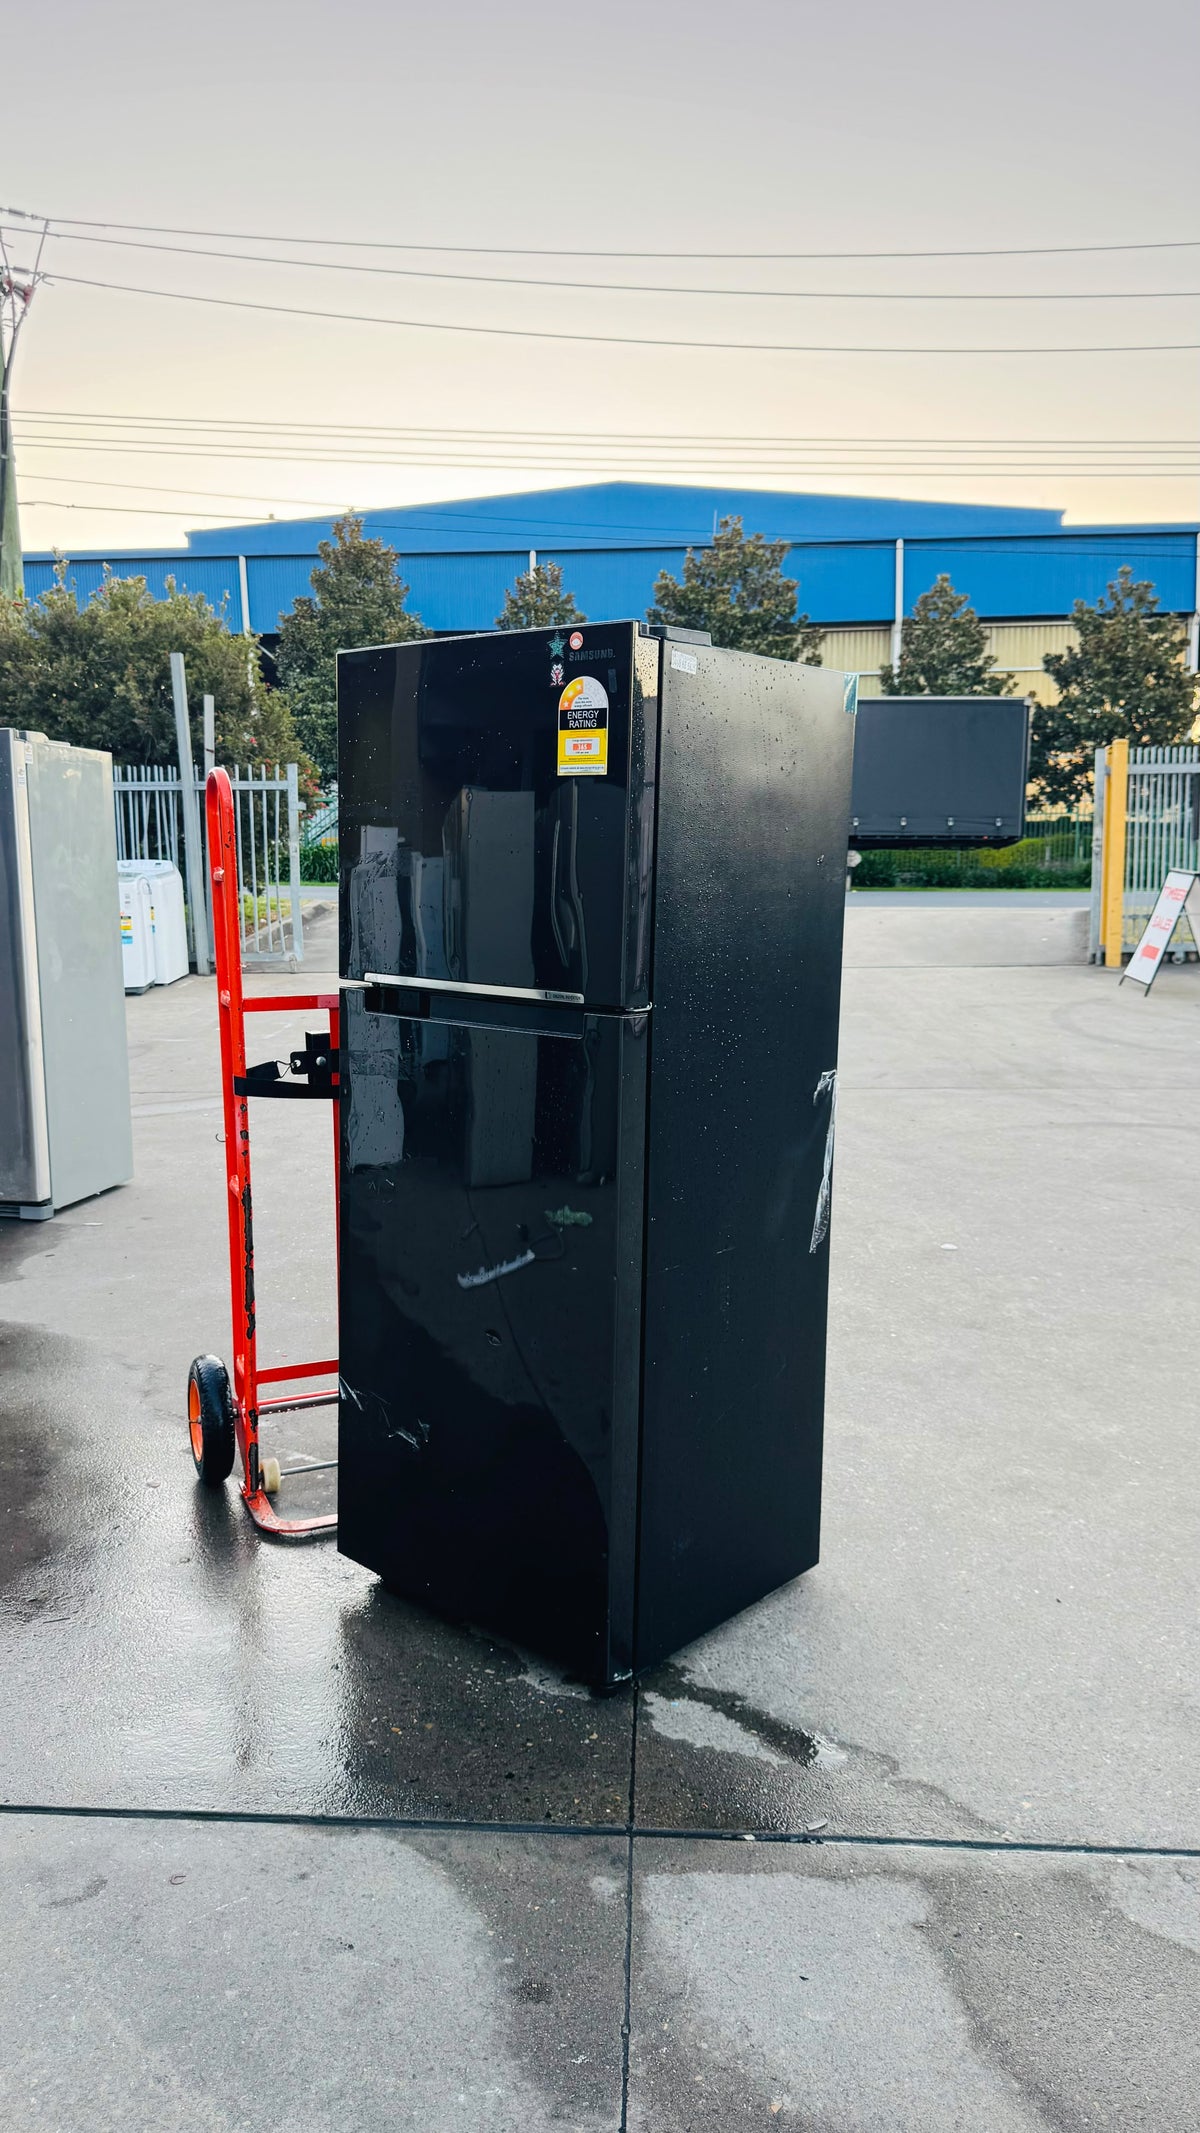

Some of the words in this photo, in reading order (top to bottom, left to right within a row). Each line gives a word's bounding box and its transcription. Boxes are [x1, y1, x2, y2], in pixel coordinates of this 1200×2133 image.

[568, 648, 614, 662] SAMSUNG
[567, 710, 599, 720] ENERGY
[569, 719, 597, 729] RATING
